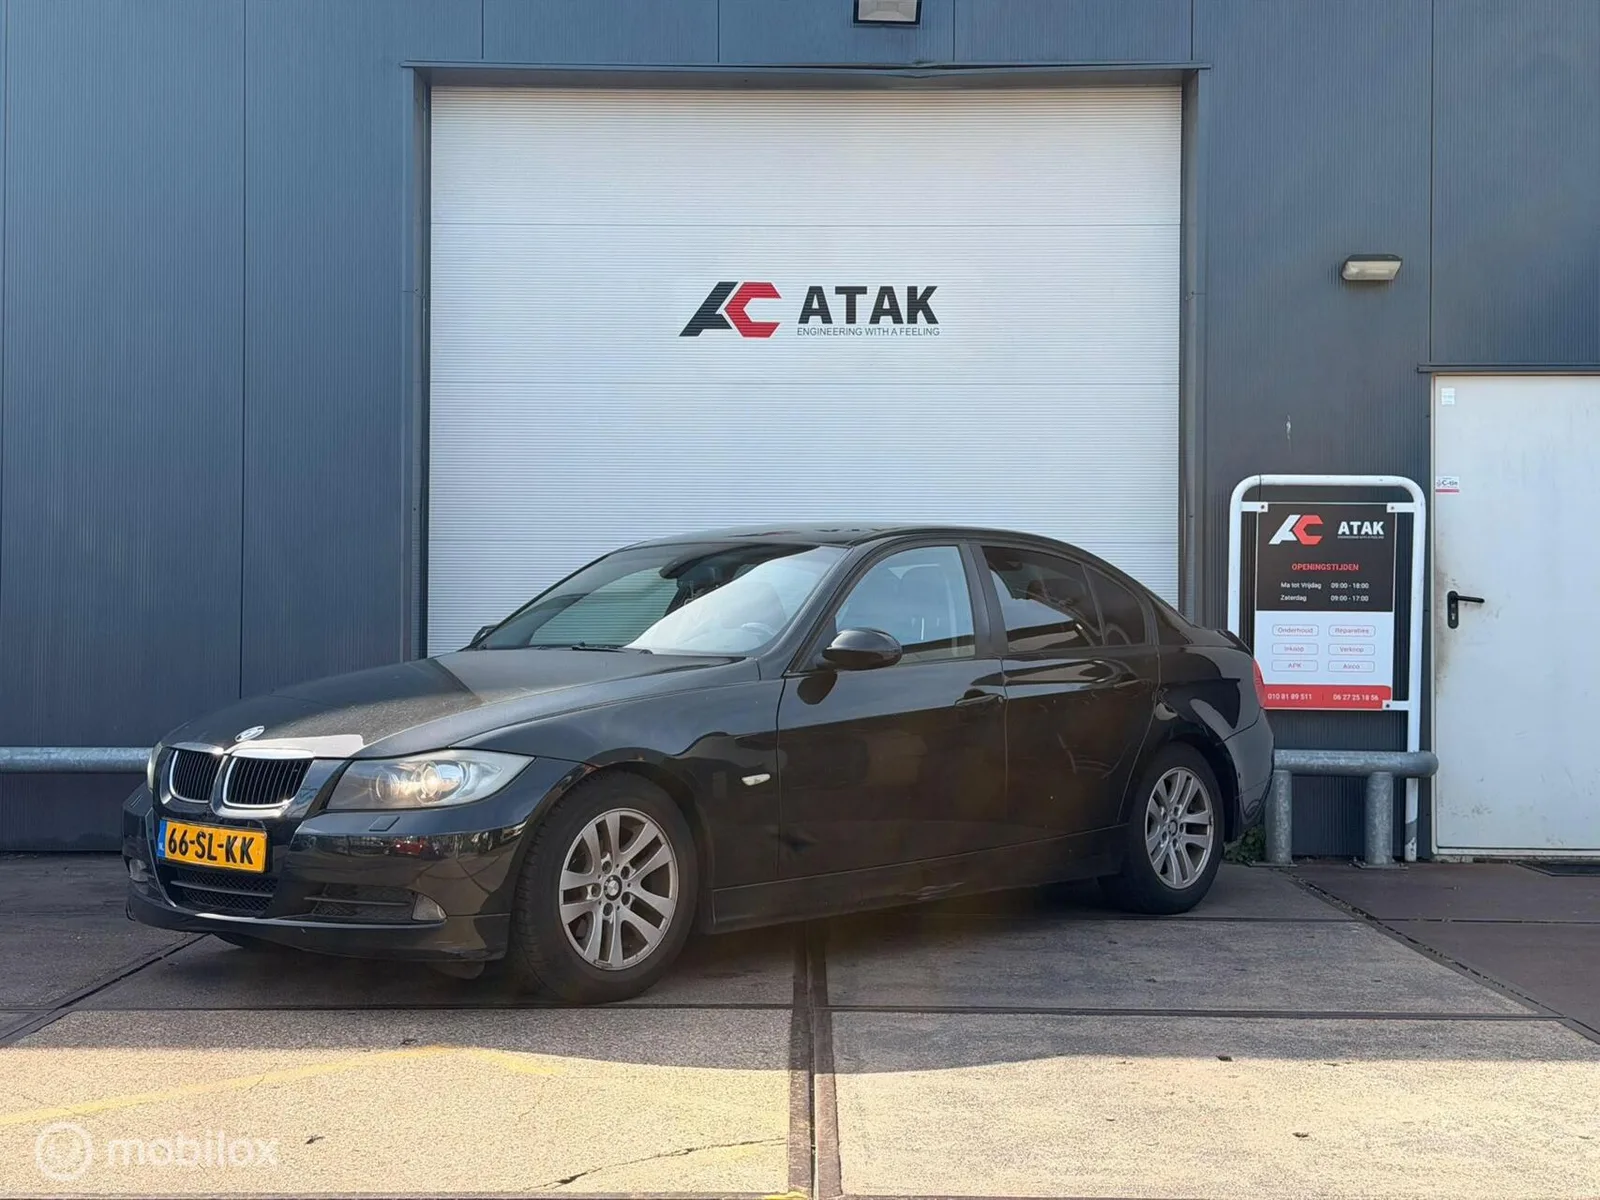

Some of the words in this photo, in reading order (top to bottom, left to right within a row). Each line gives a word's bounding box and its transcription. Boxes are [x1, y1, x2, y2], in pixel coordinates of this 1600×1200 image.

[798, 285, 939, 325] ATAK
[797, 327, 863, 336] ENGINEERING
[864, 327, 890, 336] WITH
[890, 327, 898, 336] A
[899, 327, 940, 336] FEELING
[1337, 521, 1385, 535] ATAK
[1291, 563, 1359, 571] OPENINGSTIJDEN
[1301, 582, 1322, 590] Vrijdag
[1280, 594, 1307, 602] Zaterdag
[1334, 627, 1369, 635] Reparaties
[168, 828, 254, 864] 66-SL-KK
